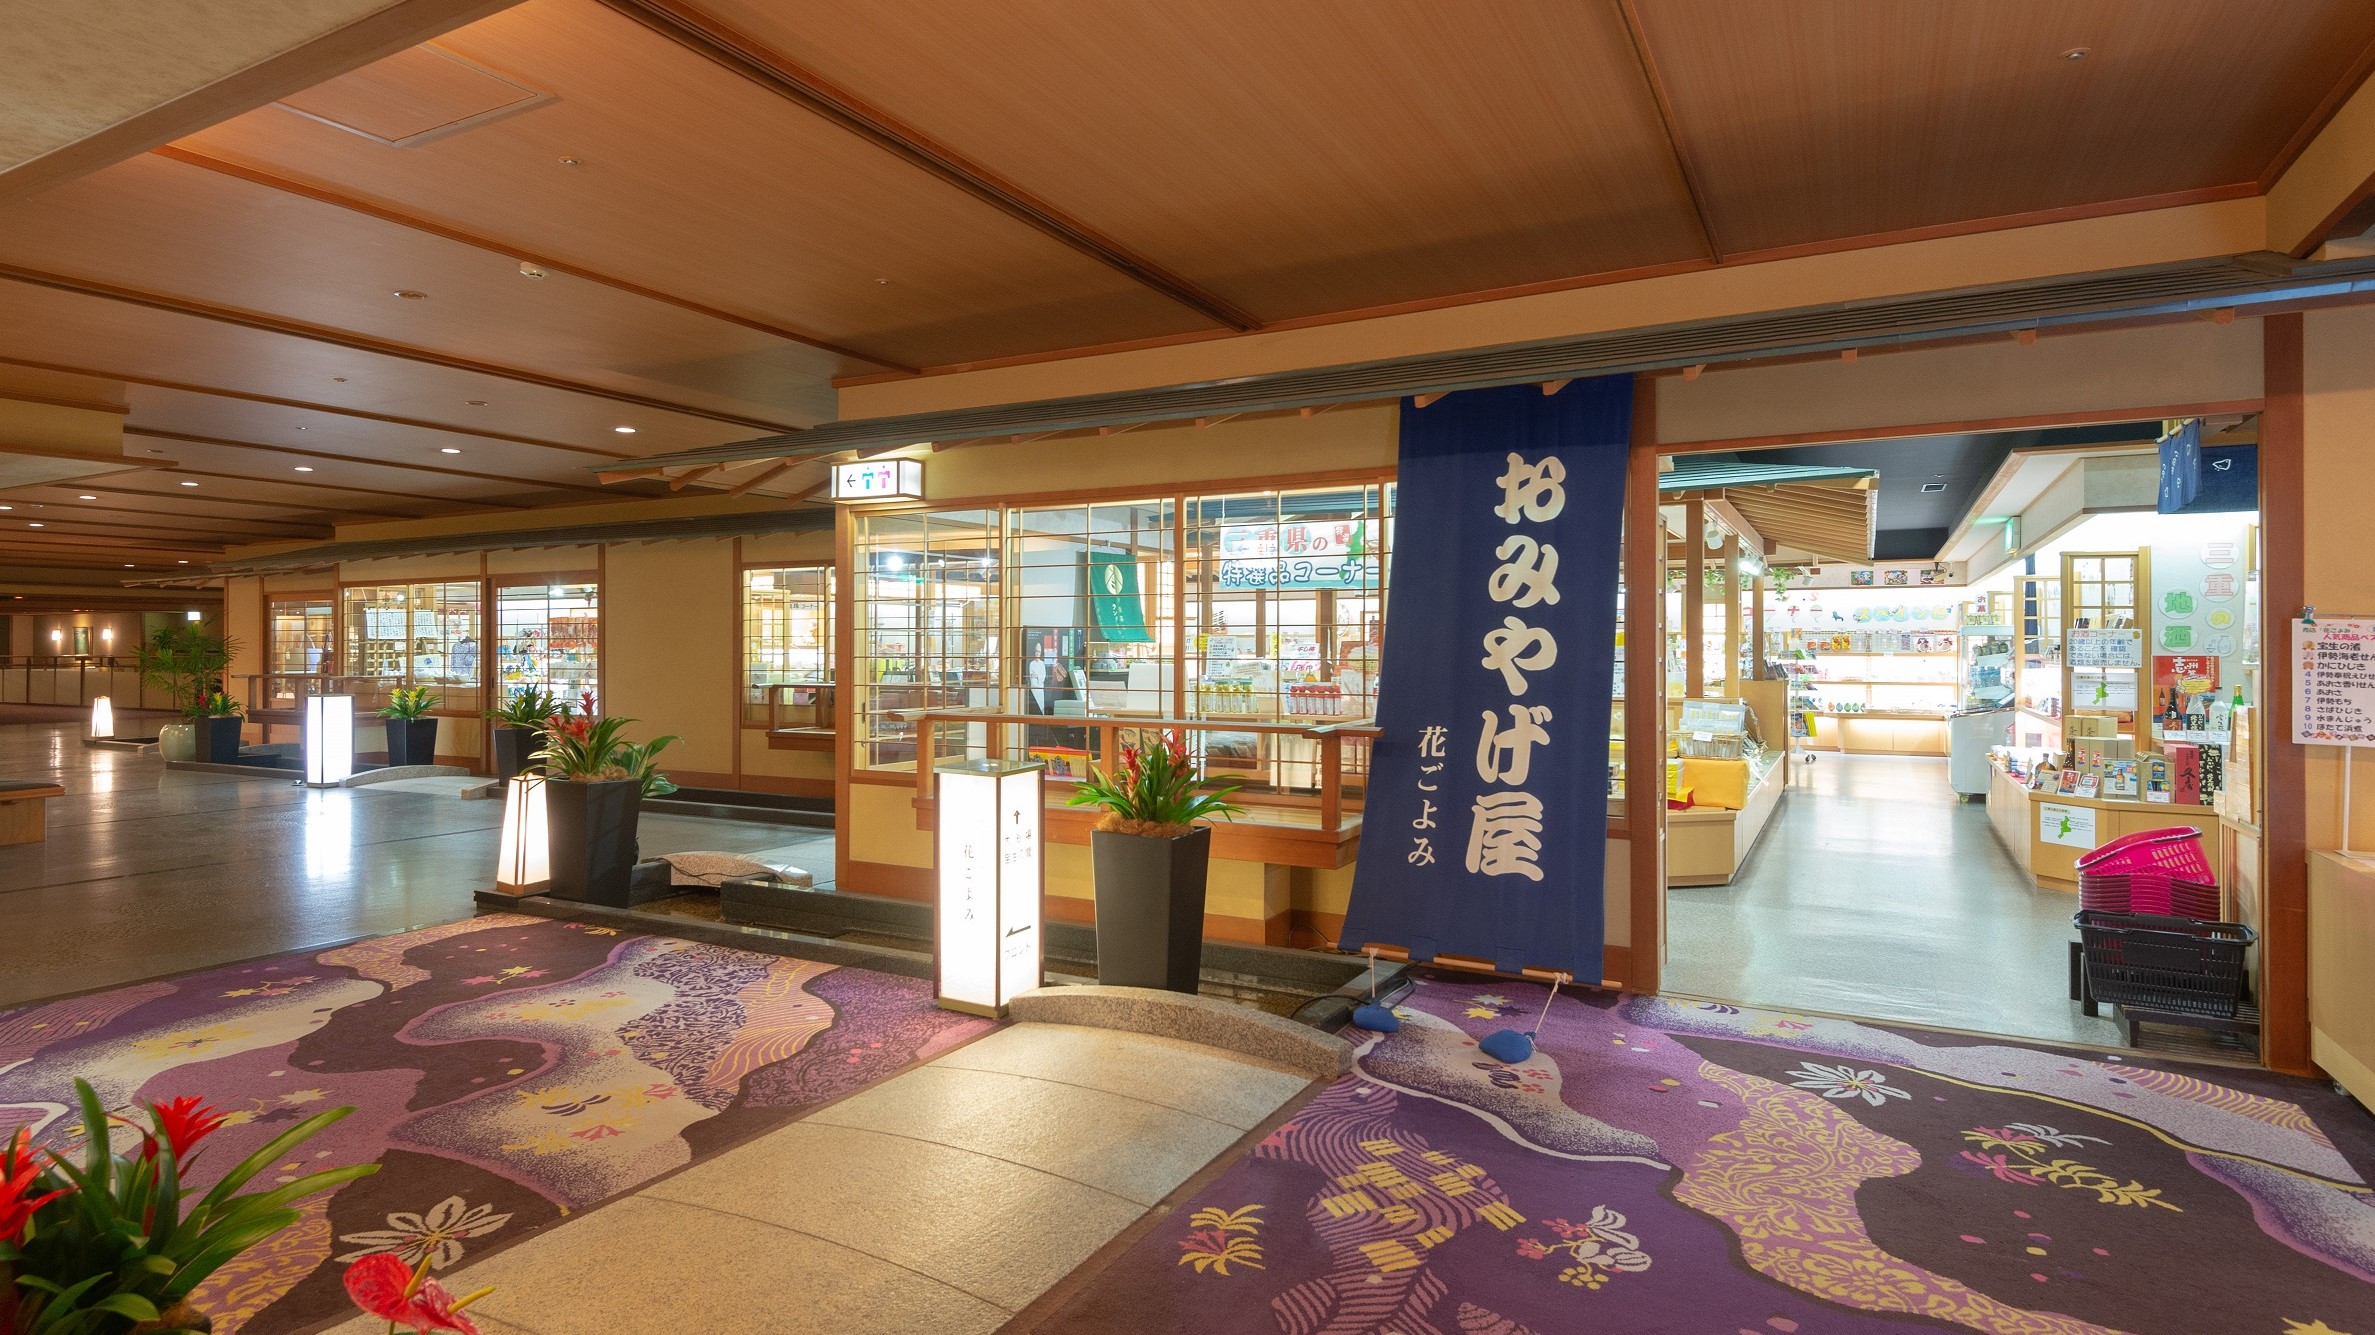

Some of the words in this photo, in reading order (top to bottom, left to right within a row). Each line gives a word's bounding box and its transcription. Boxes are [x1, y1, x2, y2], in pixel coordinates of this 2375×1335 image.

[2163, 592, 2193, 648] 地酒
[2071, 630, 2126, 638] お酒コーナー
[2317, 641, 2361, 651] 宝生の渚
[1465, 452, 1566, 881] おみやげ屋
[2317, 661, 2366, 671] かにひじき
[2316, 688, 2342, 696] あおさ
[2316, 697, 2352, 705] 伊勢もち
[2316, 706, 2362, 715] さばひじき
[1407, 726, 1448, 866] 花ごよみ
